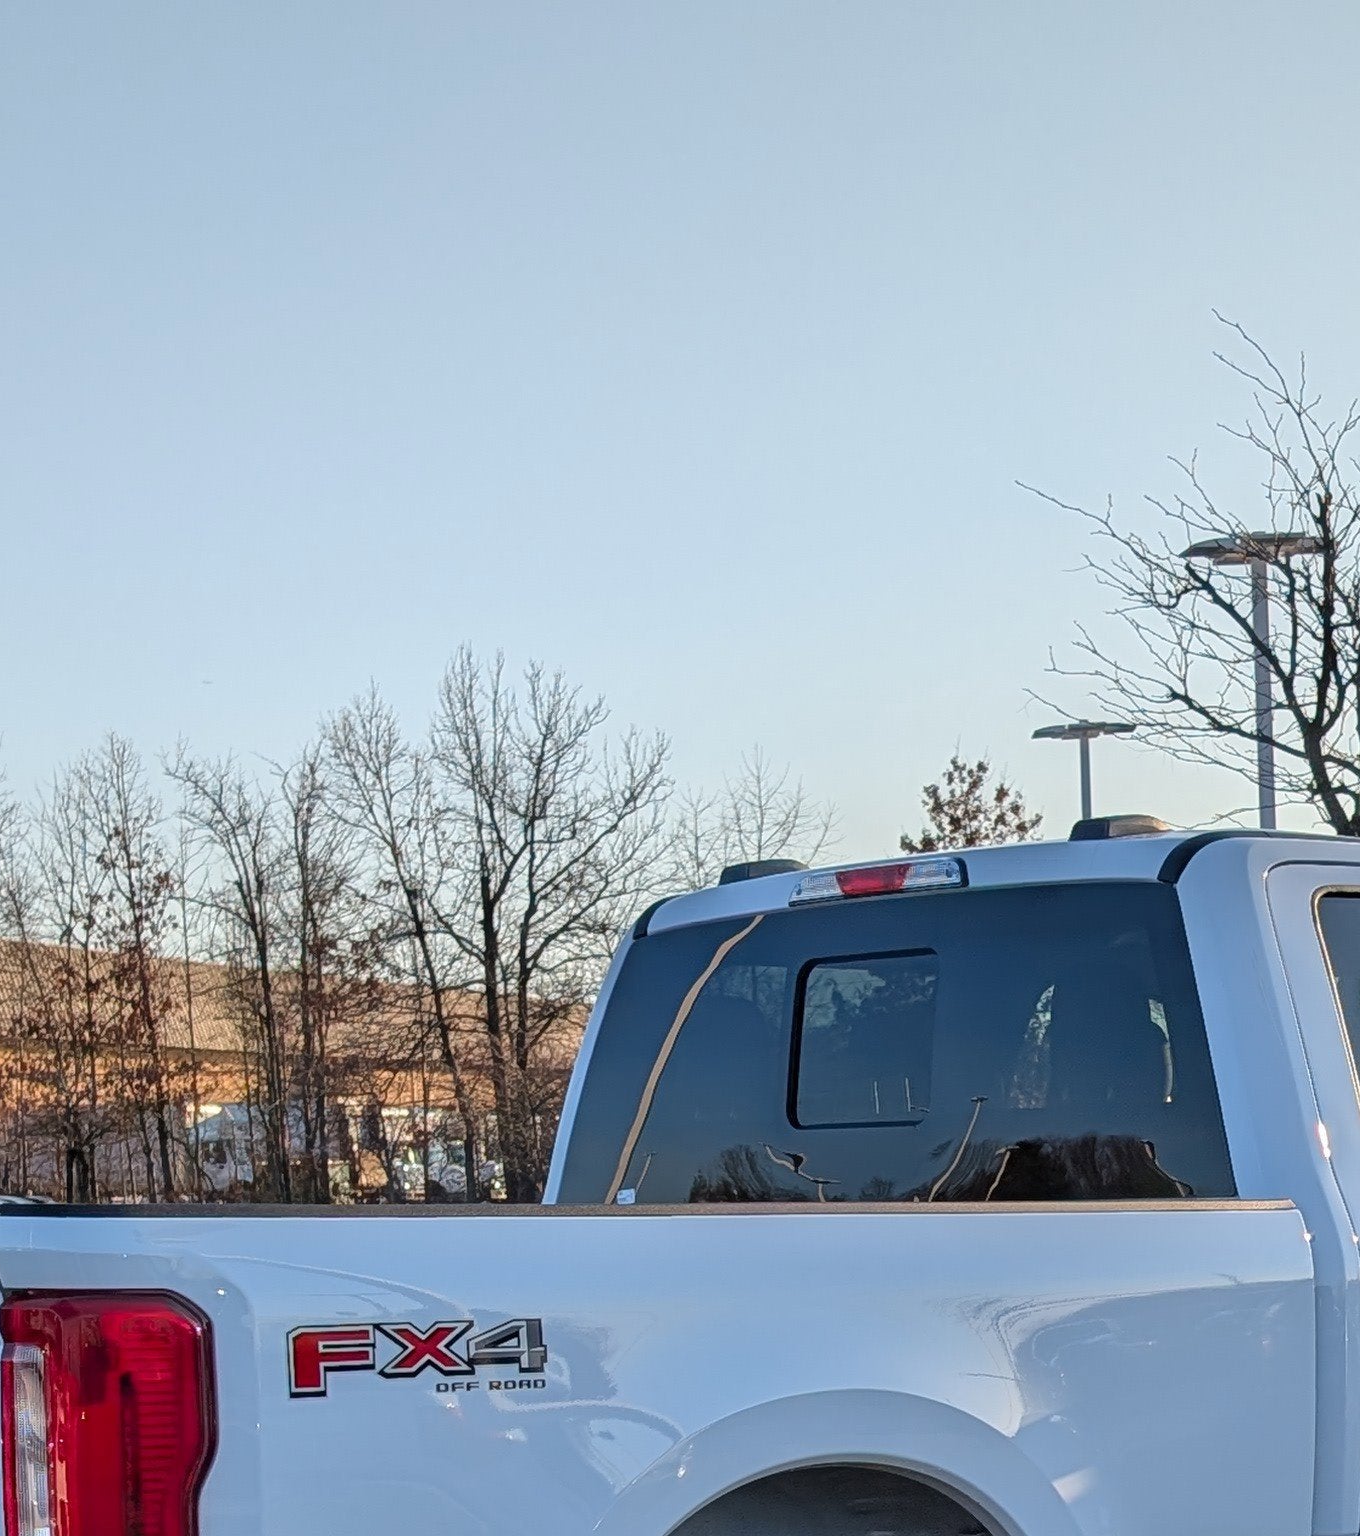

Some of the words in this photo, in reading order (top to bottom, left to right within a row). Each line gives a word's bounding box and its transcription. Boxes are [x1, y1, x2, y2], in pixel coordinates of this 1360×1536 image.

[286, 1318, 547, 1398] FX4
[436, 1381, 479, 1393] OFF
[489, 1379, 546, 1391] ROAD
